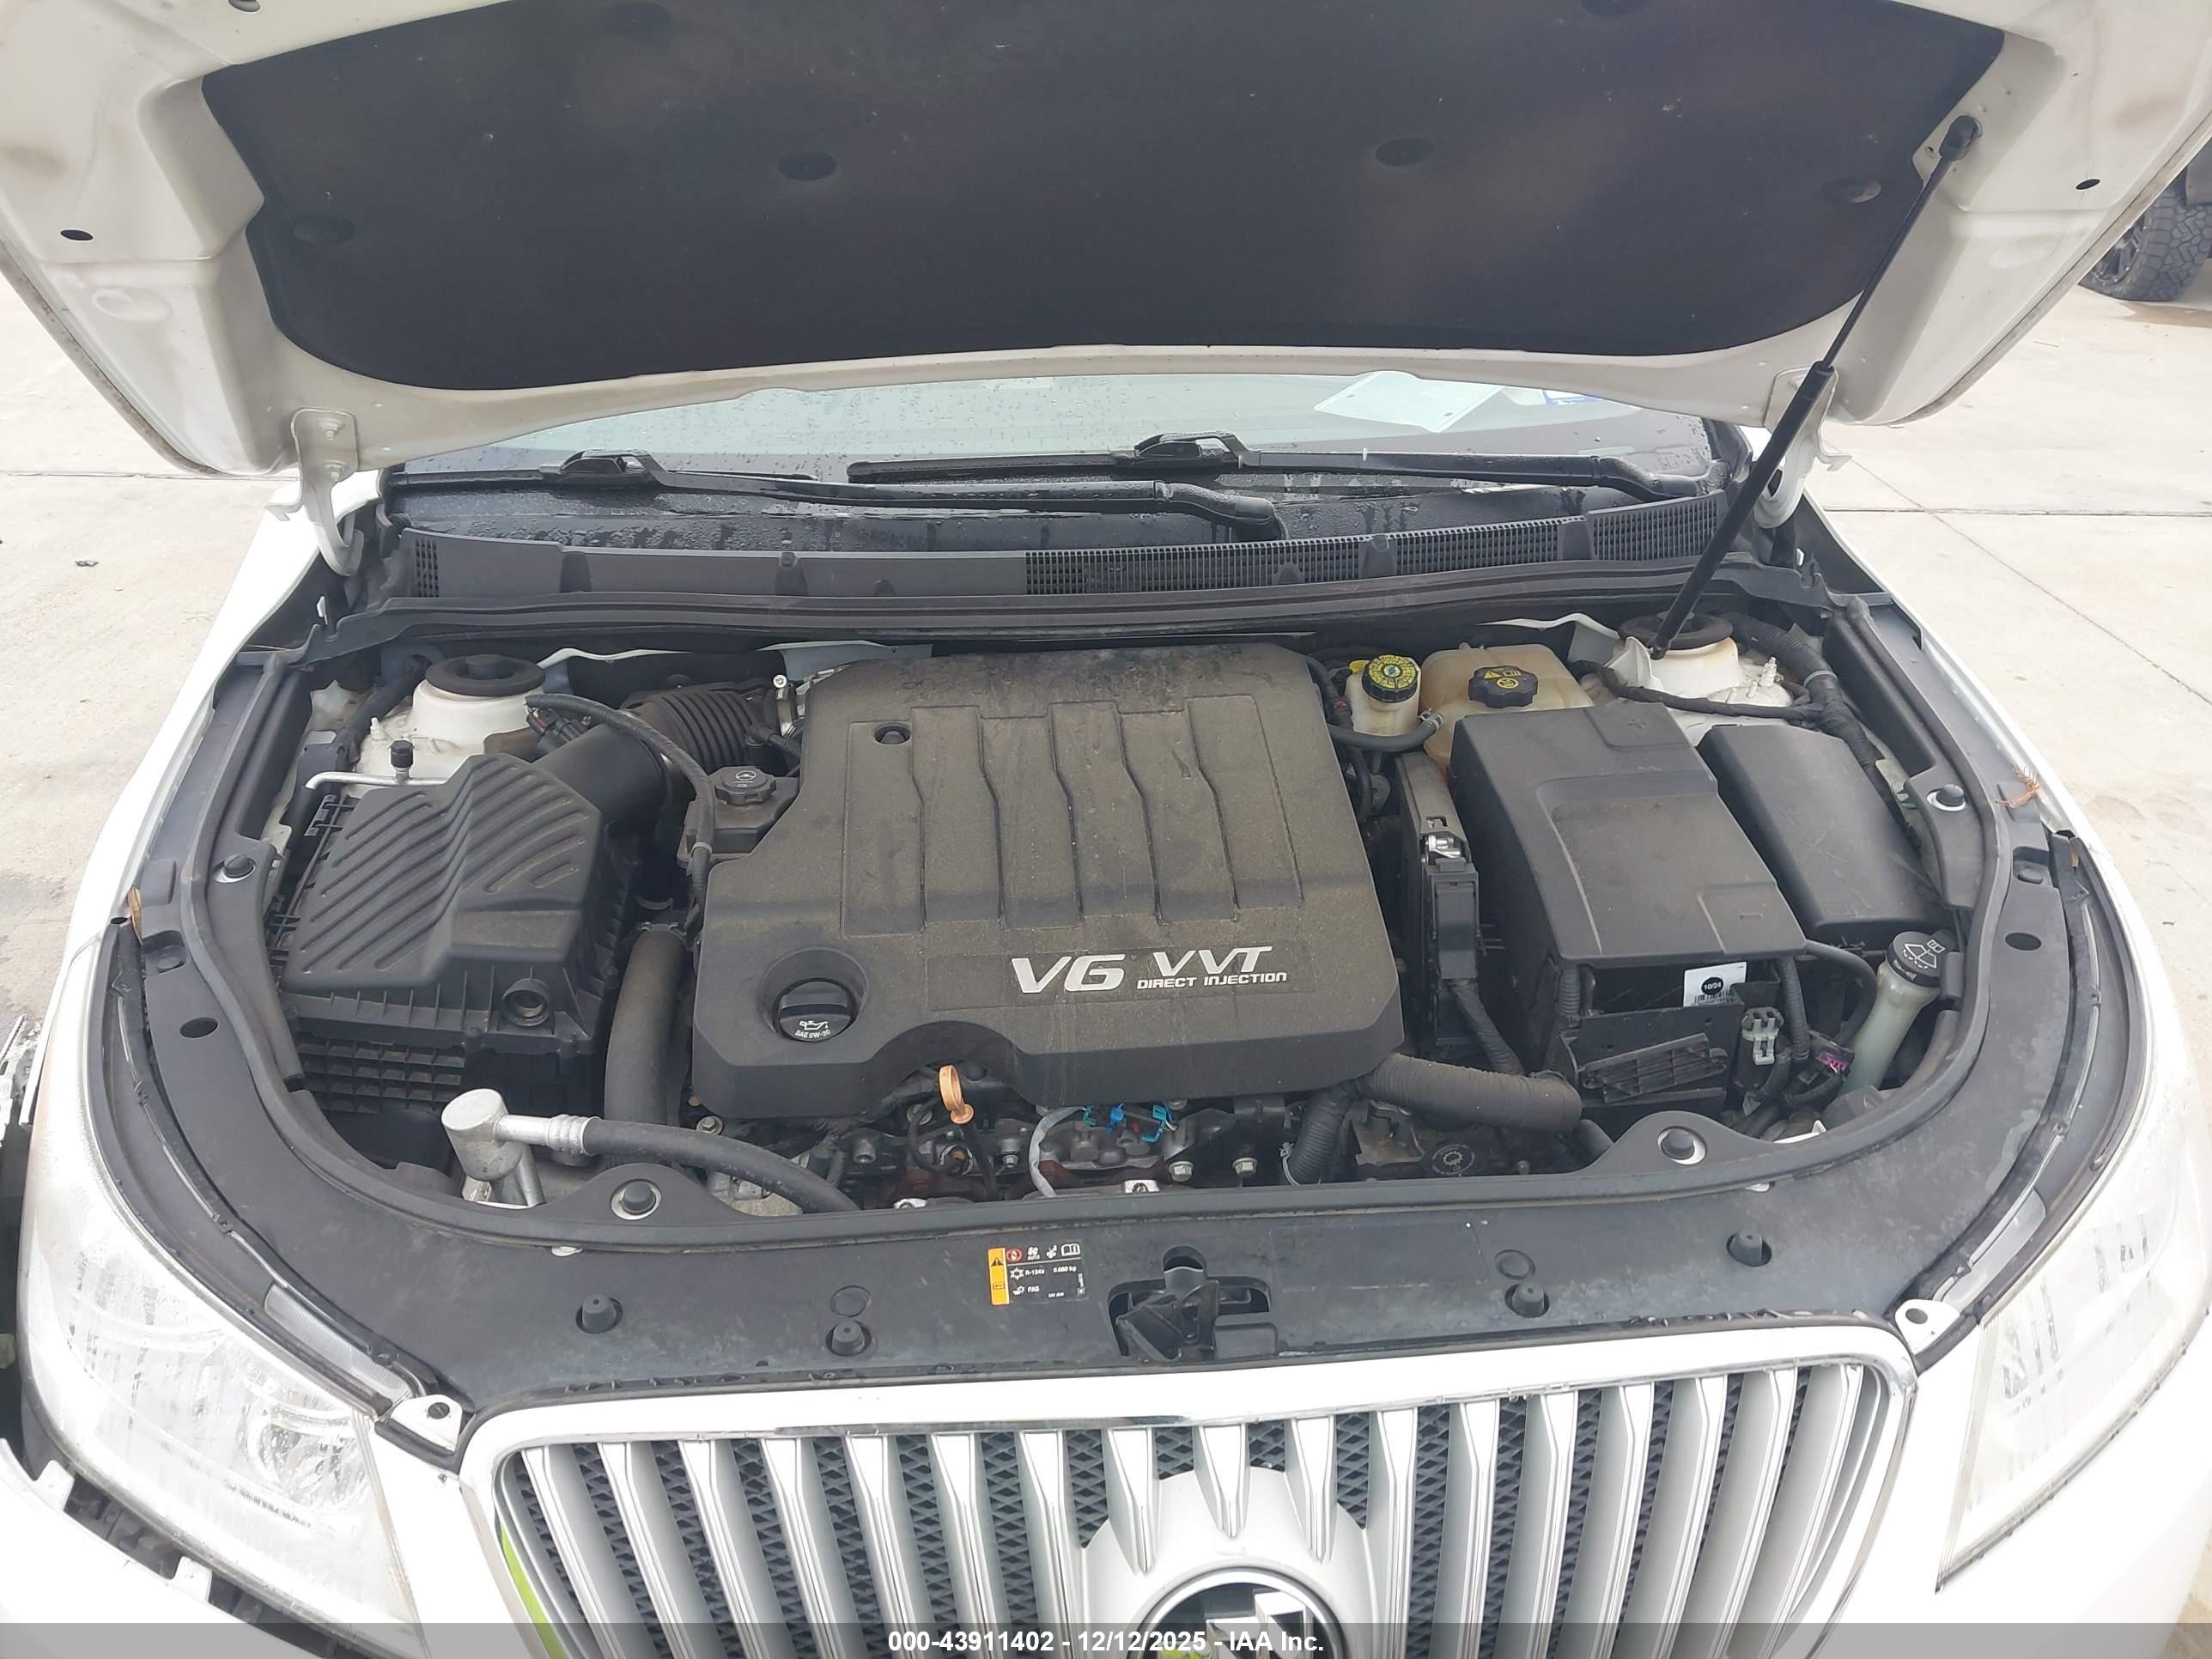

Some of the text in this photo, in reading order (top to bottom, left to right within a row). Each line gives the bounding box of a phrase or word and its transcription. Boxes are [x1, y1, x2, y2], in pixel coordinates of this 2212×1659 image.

[1012, 945, 1273, 994] V6 VVT
[1137, 973, 1287, 989] DIRECT INJECTION
[794, 1030, 809, 1038] SAE
